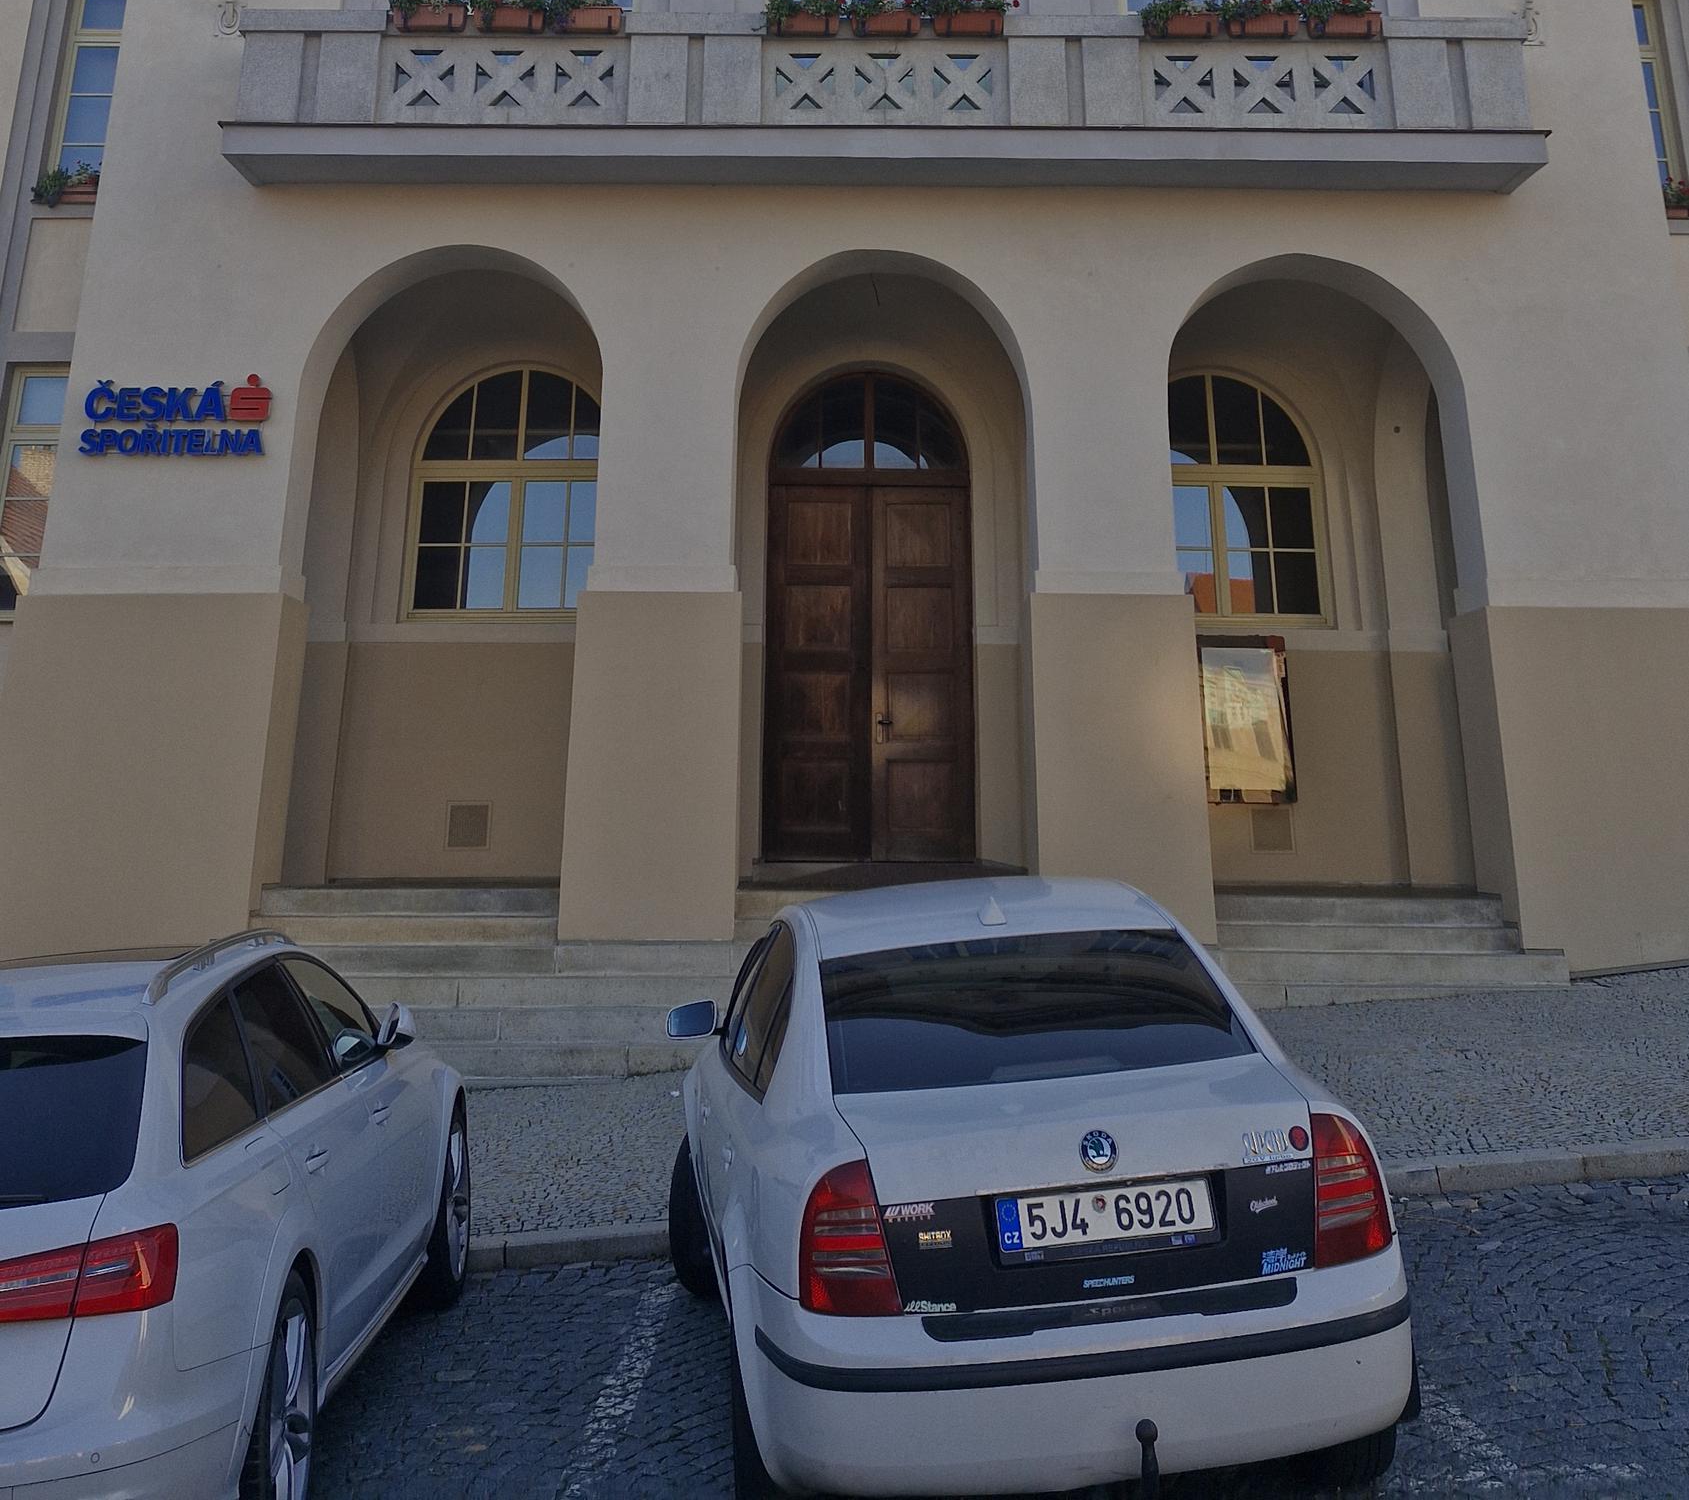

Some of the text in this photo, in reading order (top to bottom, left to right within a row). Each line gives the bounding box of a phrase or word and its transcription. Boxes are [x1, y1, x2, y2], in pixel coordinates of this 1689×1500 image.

[85, 379, 227, 422] ČESKÁ
[78, 424, 265, 457] SPOŘITELNA
[901, 1202, 935, 1216] WORK
[1026, 1187, 1195, 1241] 5J4 6920
[1004, 1232, 1020, 1244] CZ
